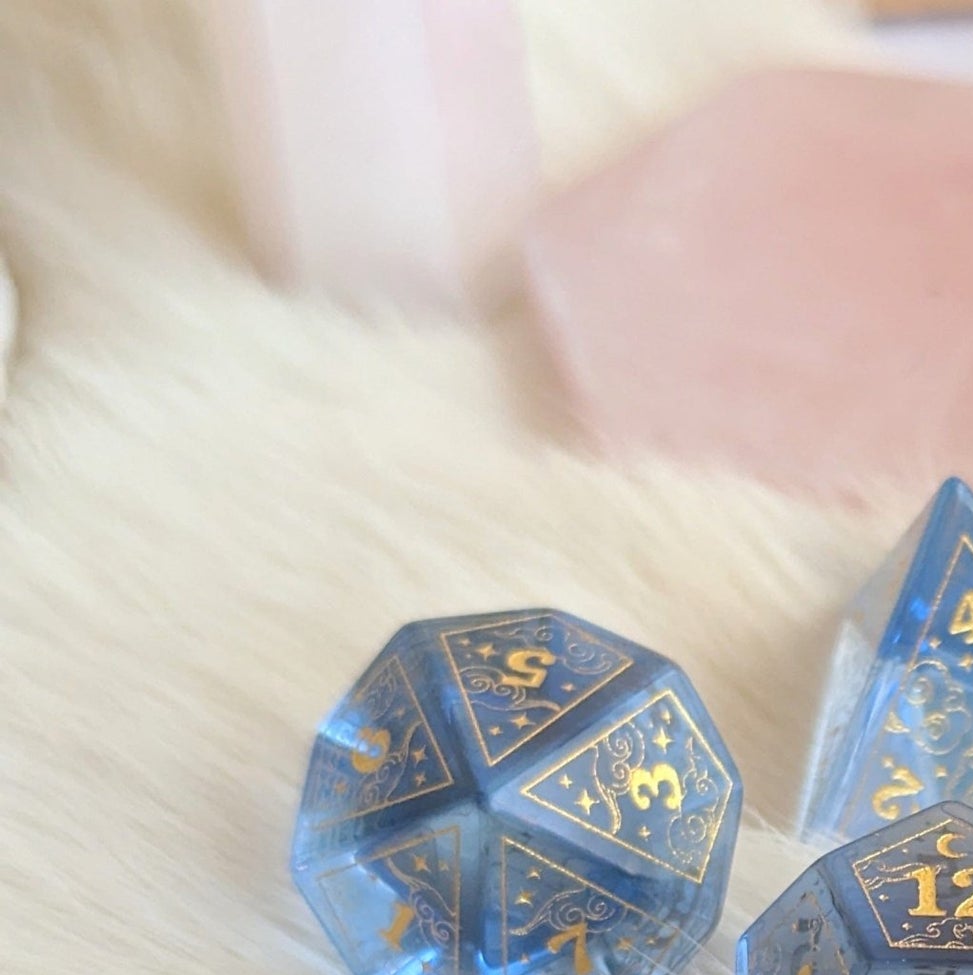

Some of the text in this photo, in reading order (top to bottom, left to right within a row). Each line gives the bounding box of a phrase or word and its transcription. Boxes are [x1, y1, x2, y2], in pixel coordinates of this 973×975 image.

[502, 647, 557, 690] 5
[630, 762, 682, 811] 3
[872, 766, 924, 820] 2
